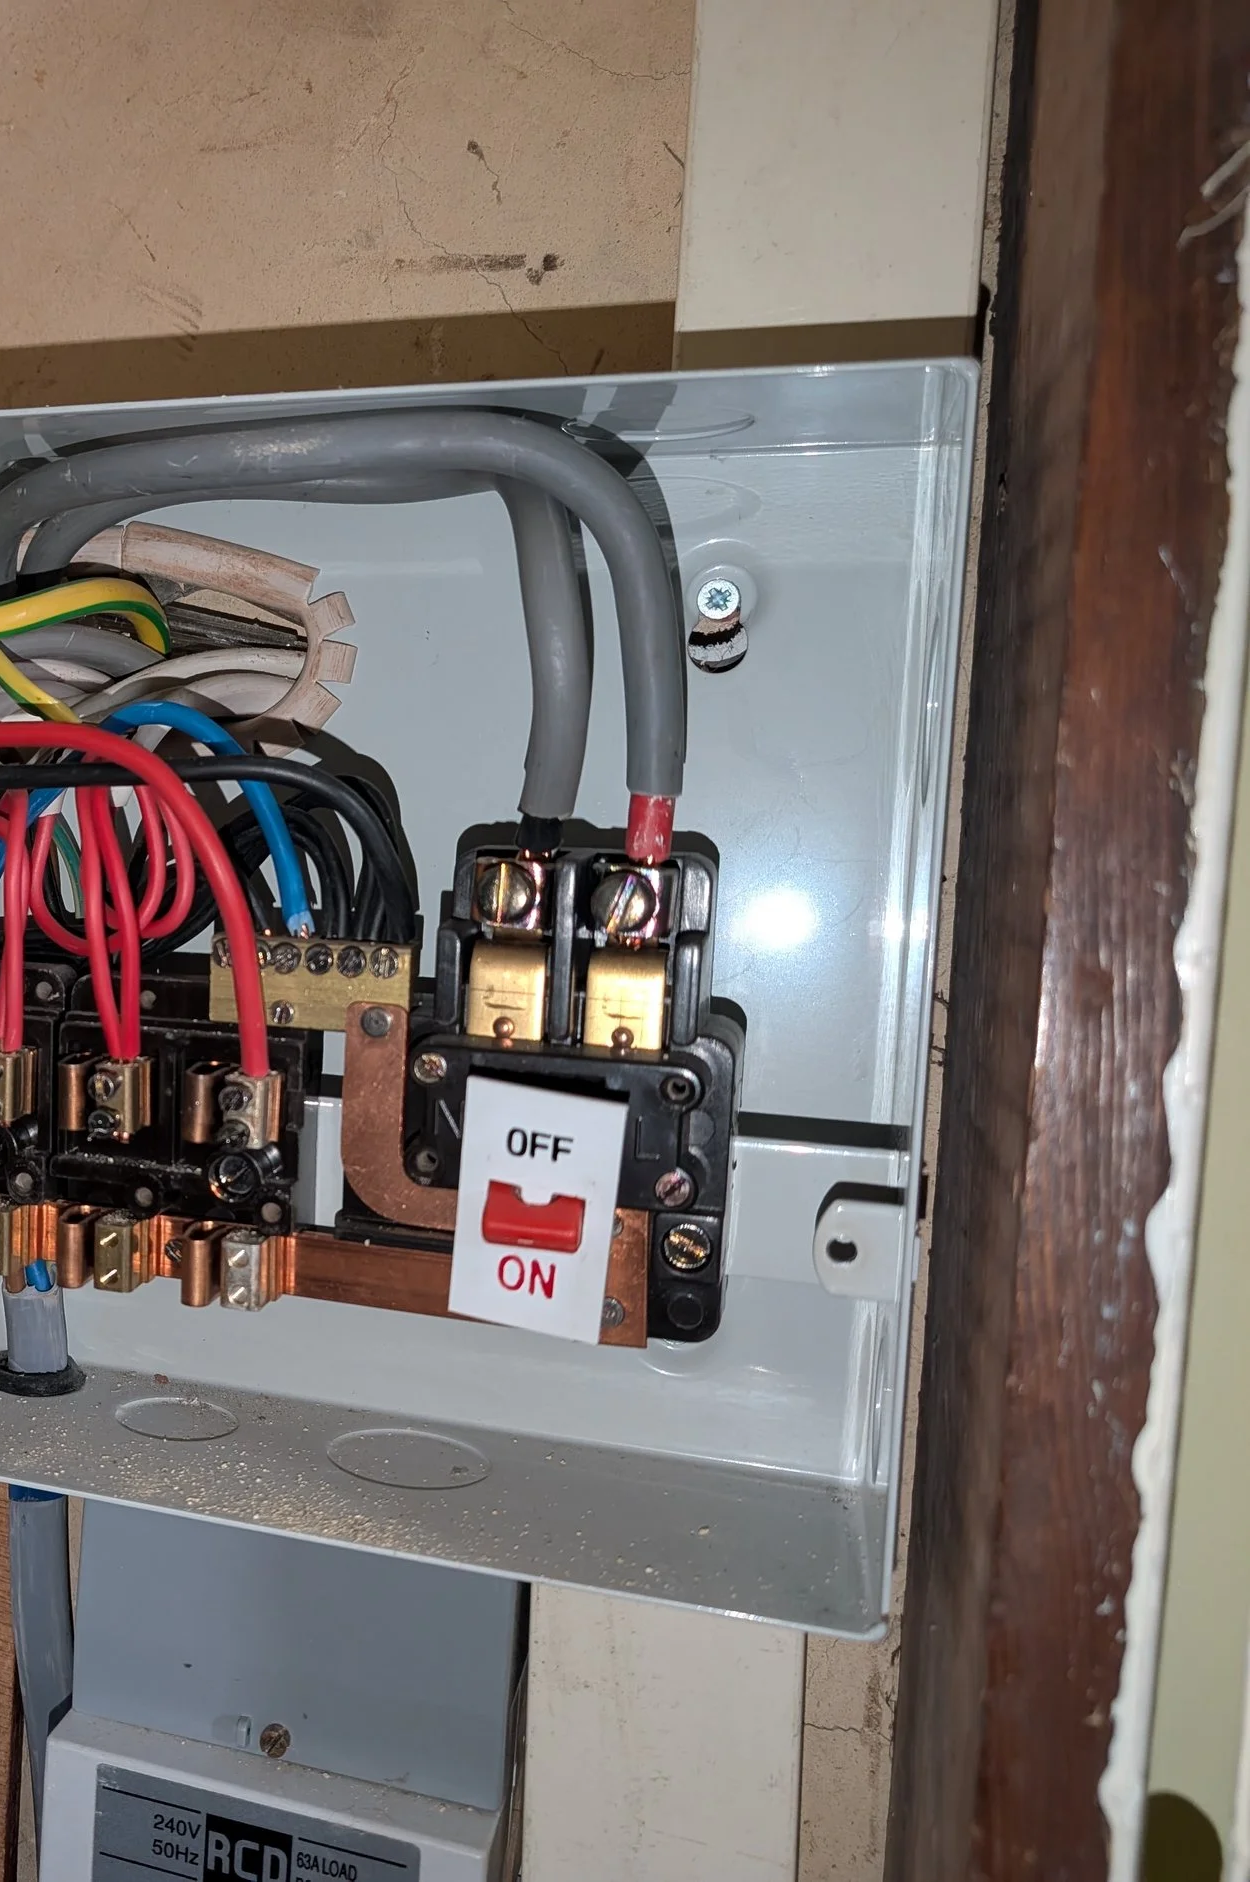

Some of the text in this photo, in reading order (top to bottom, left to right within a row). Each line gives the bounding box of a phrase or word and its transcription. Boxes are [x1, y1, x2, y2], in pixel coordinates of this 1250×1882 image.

[506, 1127, 574, 1162] OFF
[497, 1254, 556, 1299] ON
[153, 1814, 201, 1840] 240V
[152, 1838, 199, 1867] 50Hz
[207, 1830, 288, 1882] RCD
[296, 1851, 358, 1882] 63A LOAD
